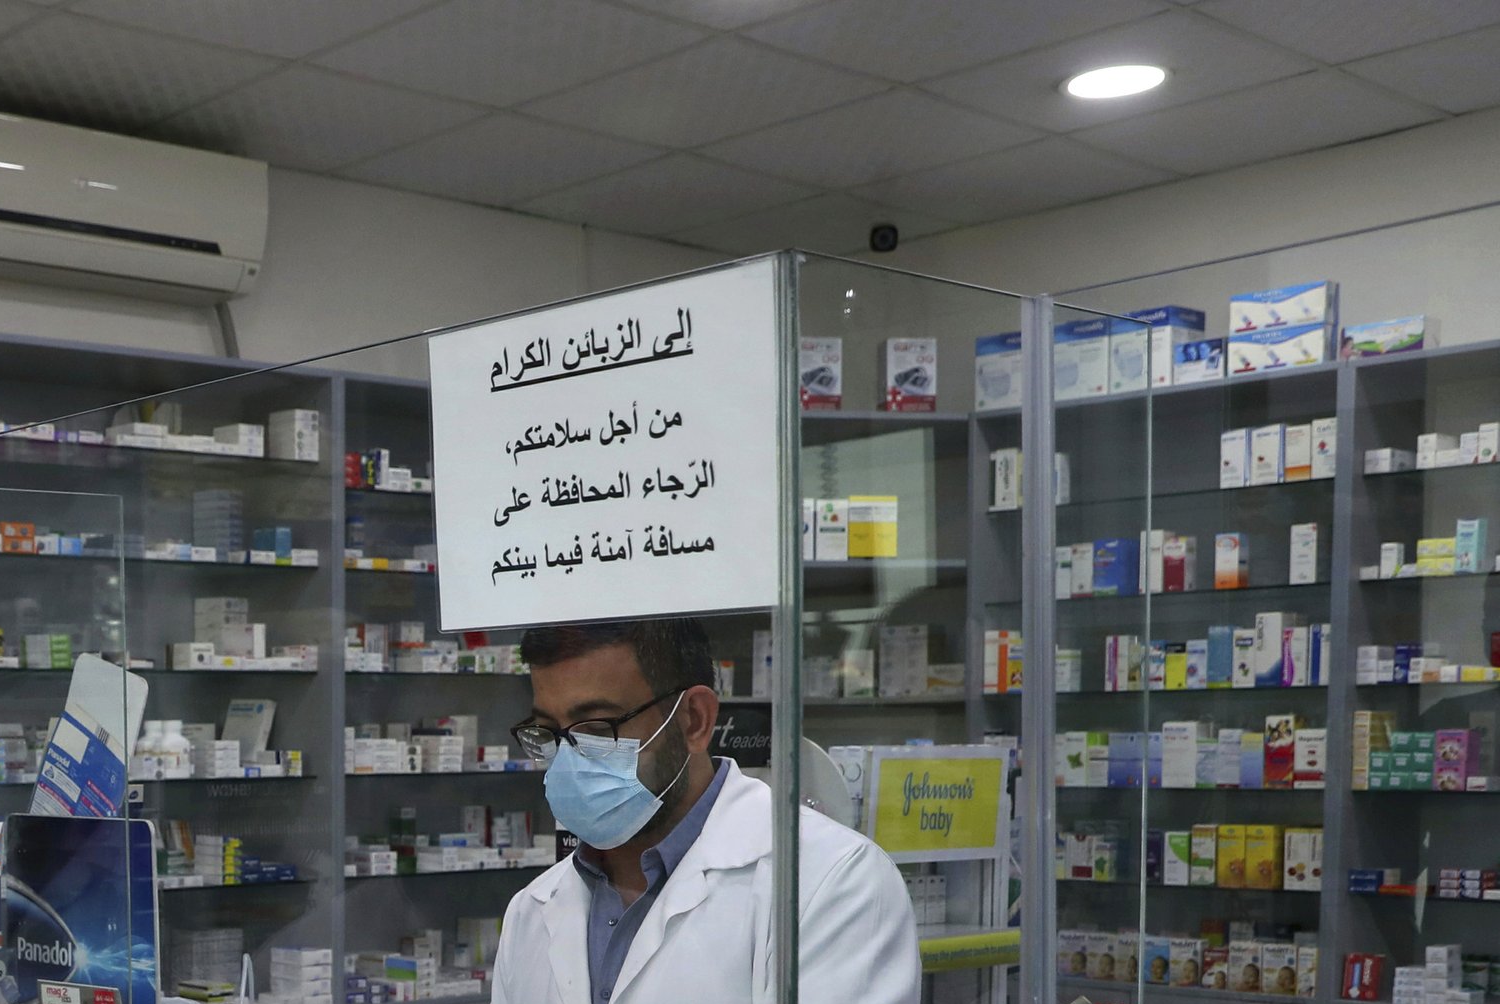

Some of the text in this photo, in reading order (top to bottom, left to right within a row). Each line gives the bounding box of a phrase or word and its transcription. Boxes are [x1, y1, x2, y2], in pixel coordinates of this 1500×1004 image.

[491, 307, 692, 387] إلى الزبائن الكرام
[600, 402, 638, 445] أجل
[648, 407, 682, 439] من
[494, 487, 531, 526] على
[542, 472, 630, 507] المحافظة
[491, 526, 715, 585] مسافة آمنة فيما بينكم
[903, 772, 975, 816] Johnson's
[920, 806, 953, 837] baby
[18, 937, 73, 967] Panadol
